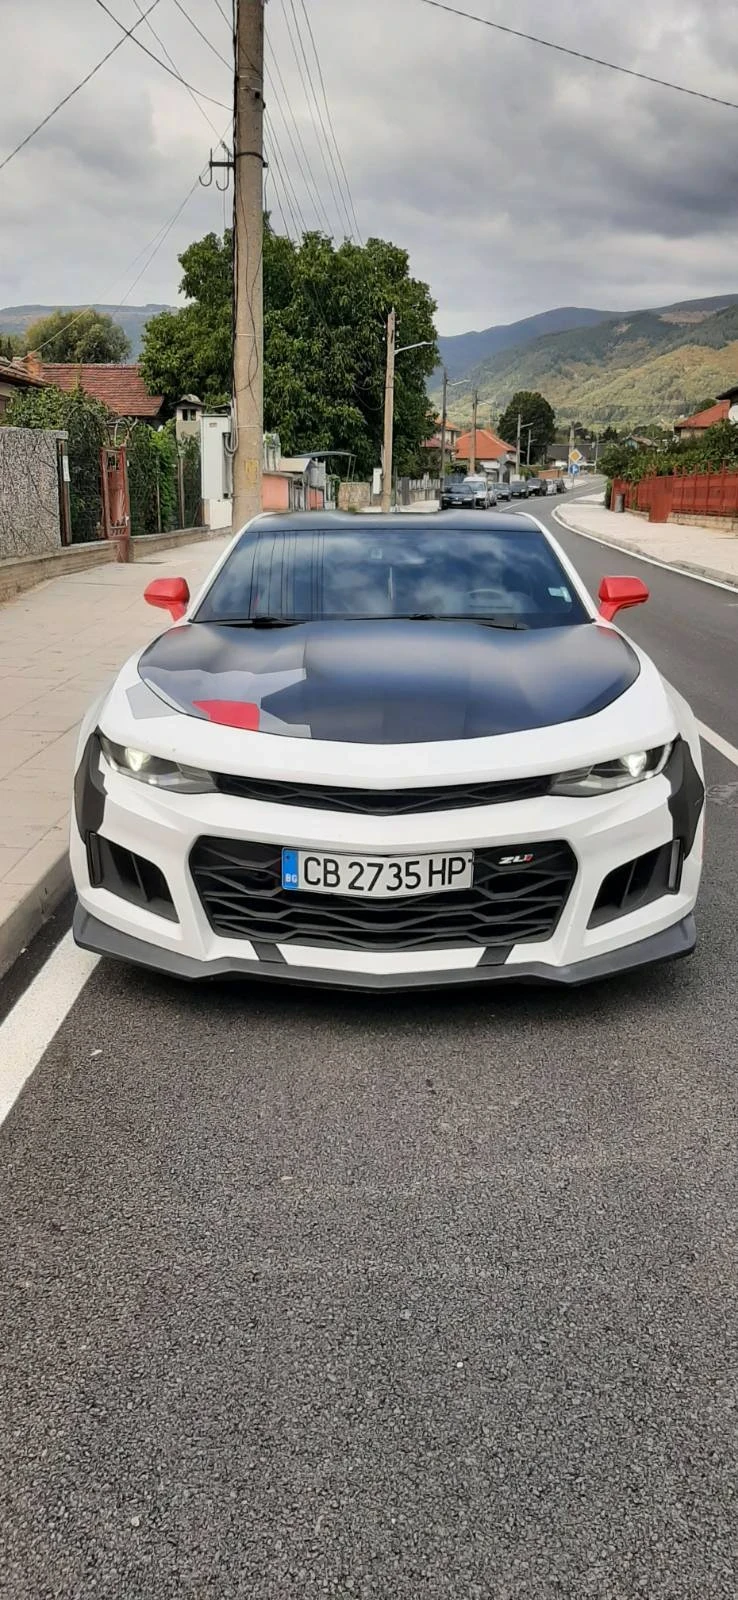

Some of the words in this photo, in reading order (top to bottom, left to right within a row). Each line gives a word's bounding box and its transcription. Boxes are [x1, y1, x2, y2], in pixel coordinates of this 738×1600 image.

[285, 872, 298, 883] BG
[303, 856, 341, 887] CB
[348, 860, 421, 891] 2735
[428, 856, 466, 887] HP
